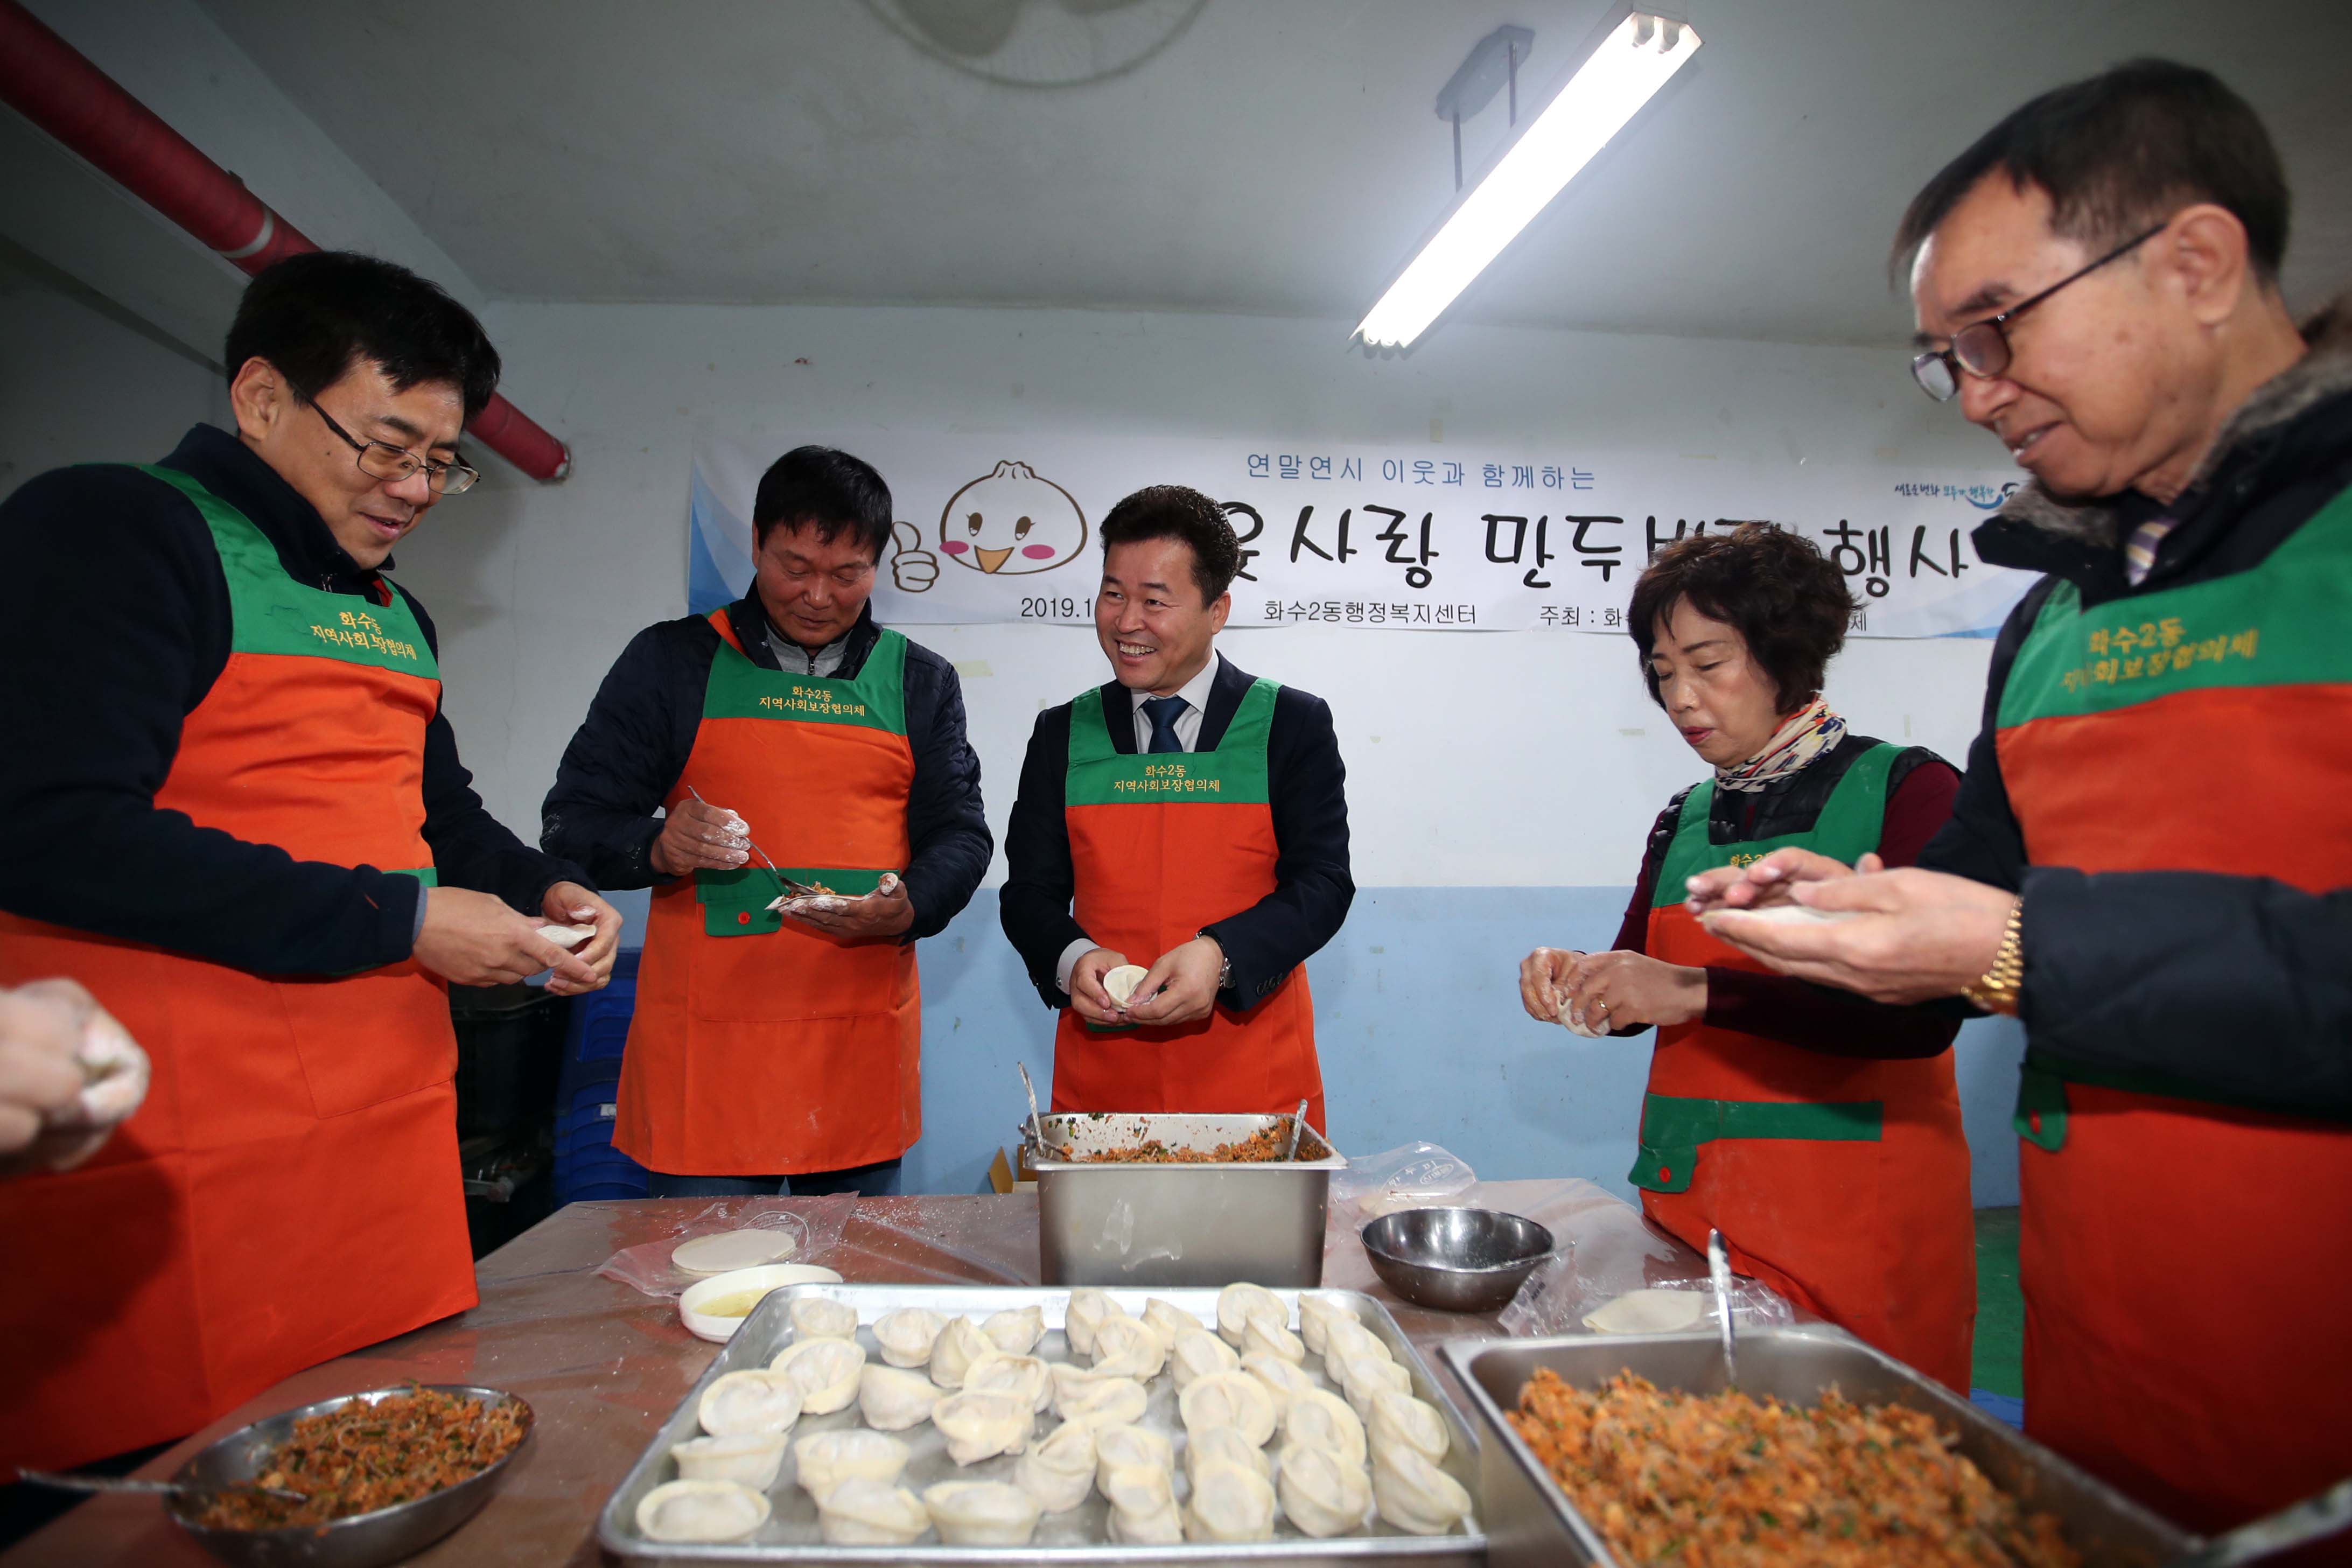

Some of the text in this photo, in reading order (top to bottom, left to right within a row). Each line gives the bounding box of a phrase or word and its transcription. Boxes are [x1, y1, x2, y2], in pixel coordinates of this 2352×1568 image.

[1247, 453, 1595, 491] 연말연시 이웃과 함께하는
[1823, 519, 1970, 598] 행사
[1264, 600, 1476, 625] 화수2동행정복지센터
[1539, 605, 1580, 627] 주최
[1603, 607, 1628, 628] 화
[792, 685, 833, 703] 화수2동
[759, 696, 866, 717] 지역사회보장협의체
[1145, 764, 1187, 778] 화수2동
[1113, 779, 1221, 793] 지역사회보장협의체
[1730, 851, 1775, 870] 화수2
